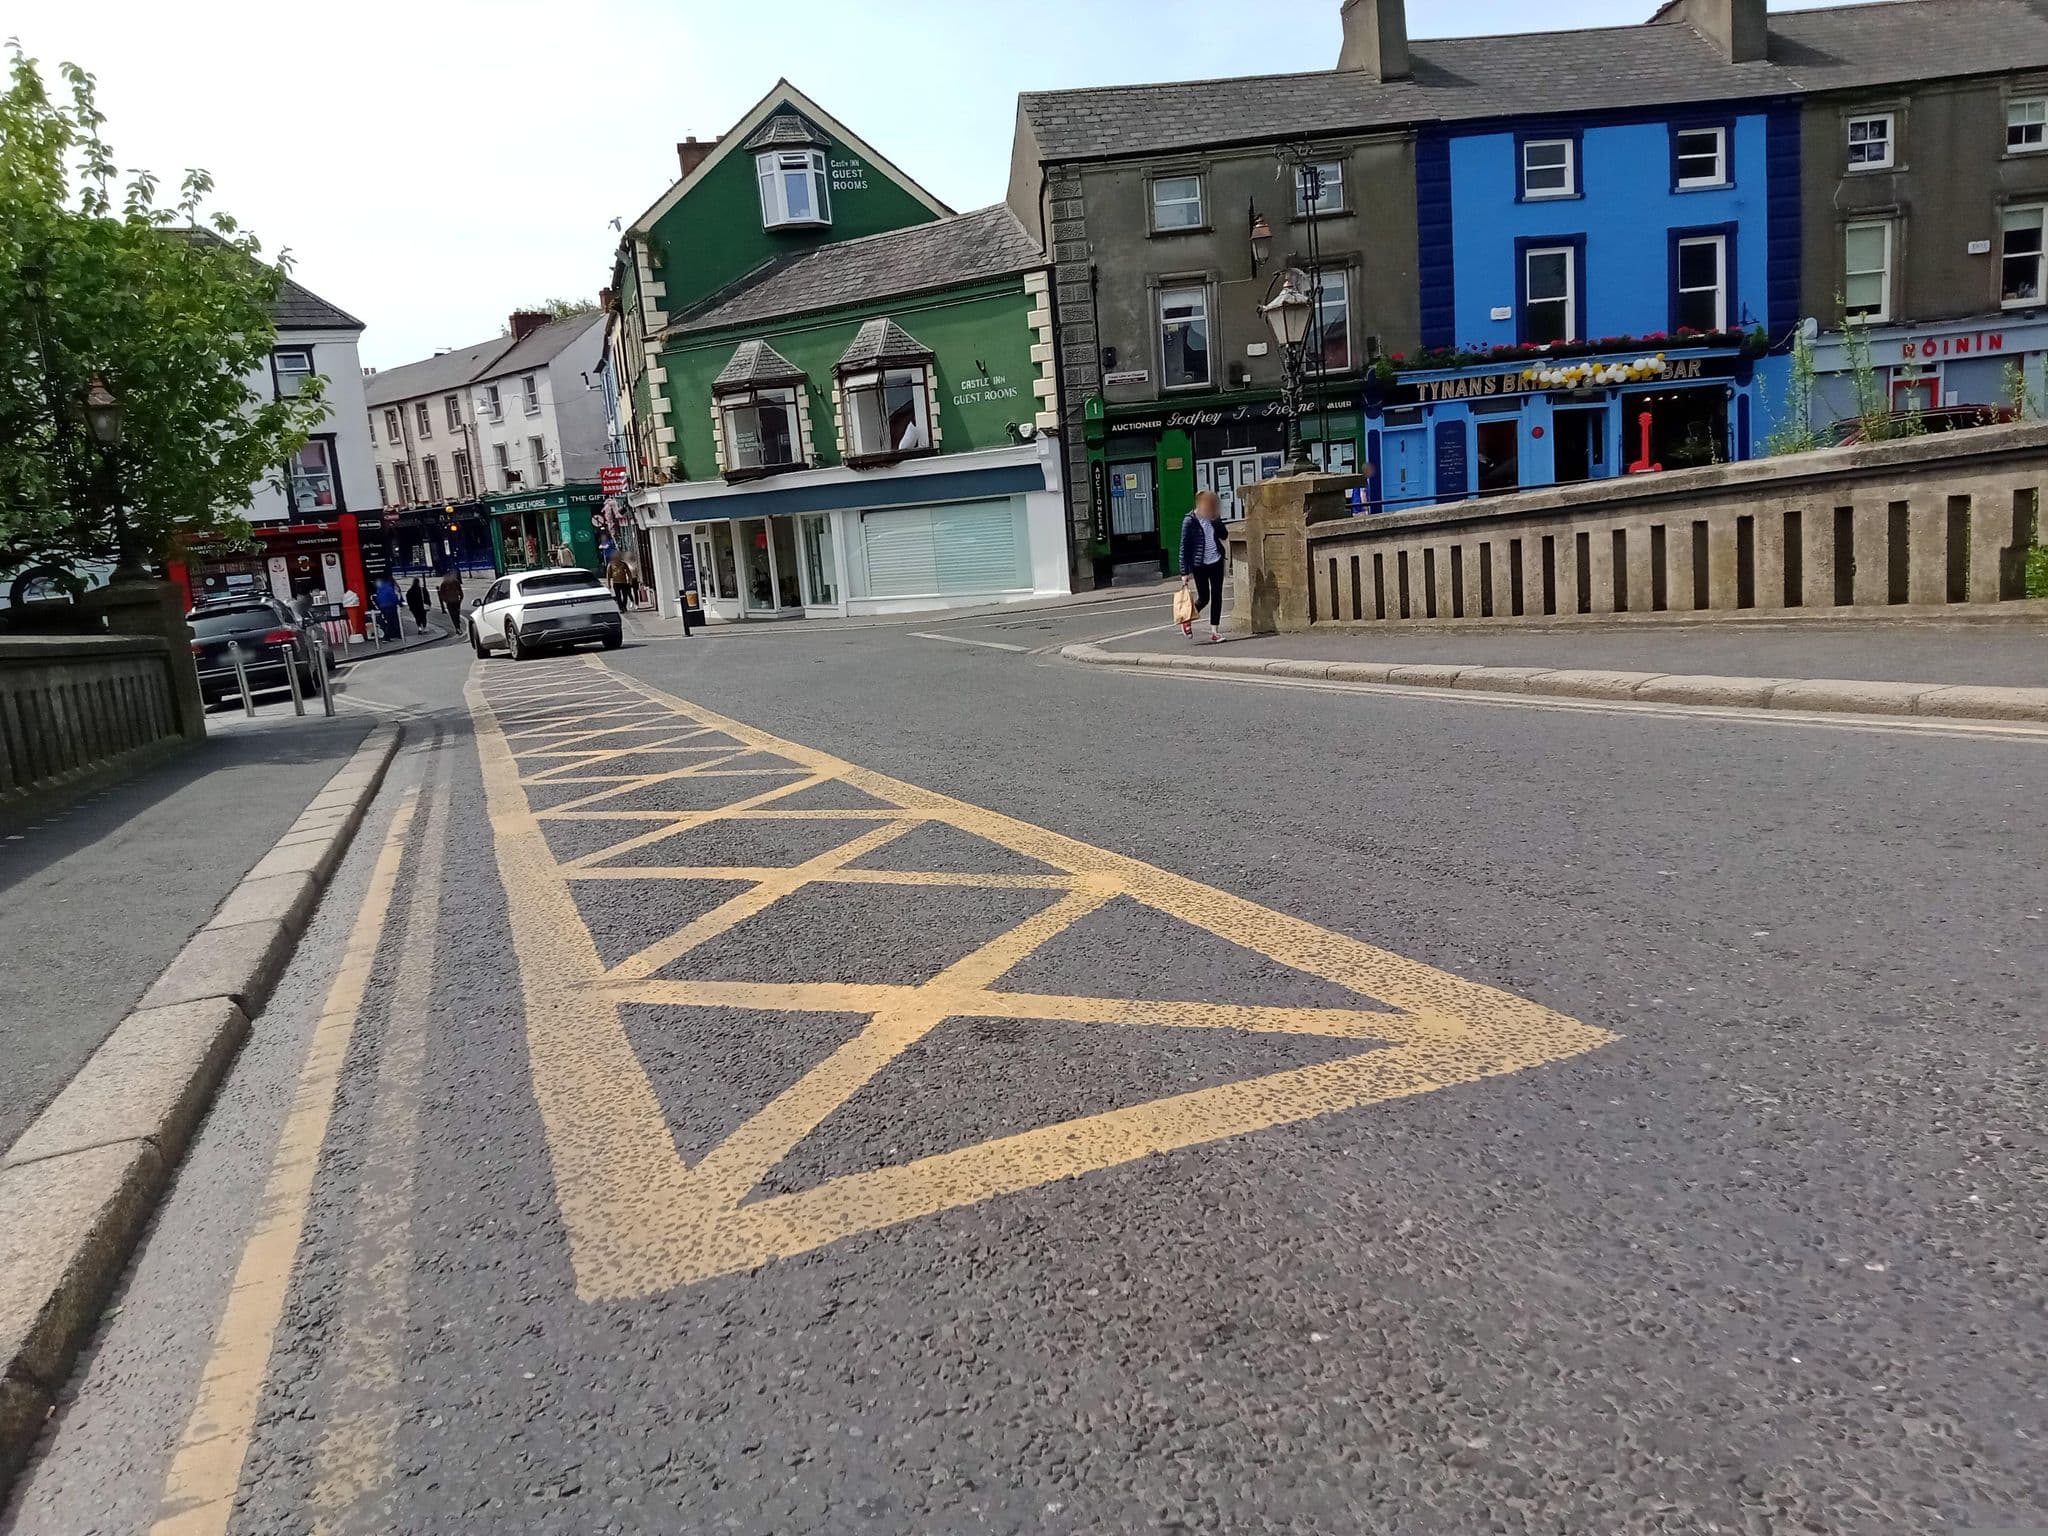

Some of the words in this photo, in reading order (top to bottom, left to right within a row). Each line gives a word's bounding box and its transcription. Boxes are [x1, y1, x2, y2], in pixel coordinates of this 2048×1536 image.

[832, 169, 863, 179] GUEST
[833, 181, 868, 190] ROOMS
[961, 378, 989, 390] CASTLE
[993, 376, 1006, 385] INN
[1417, 376, 1495, 401] TYNANS
[1660, 359, 1701, 380] BAR
[953, 393, 981, 406] GUEST
[984, 387, 1018, 401] ROOMS
[1112, 420, 1162, 432] AUCTIONEER
[1166, 410, 1222, 426] Godfrey
[505, 502, 516, 511] THE
[529, 498, 547, 508] HORSE
[569, 495, 587, 503] THE
[588, 493, 606, 501] GIFT
